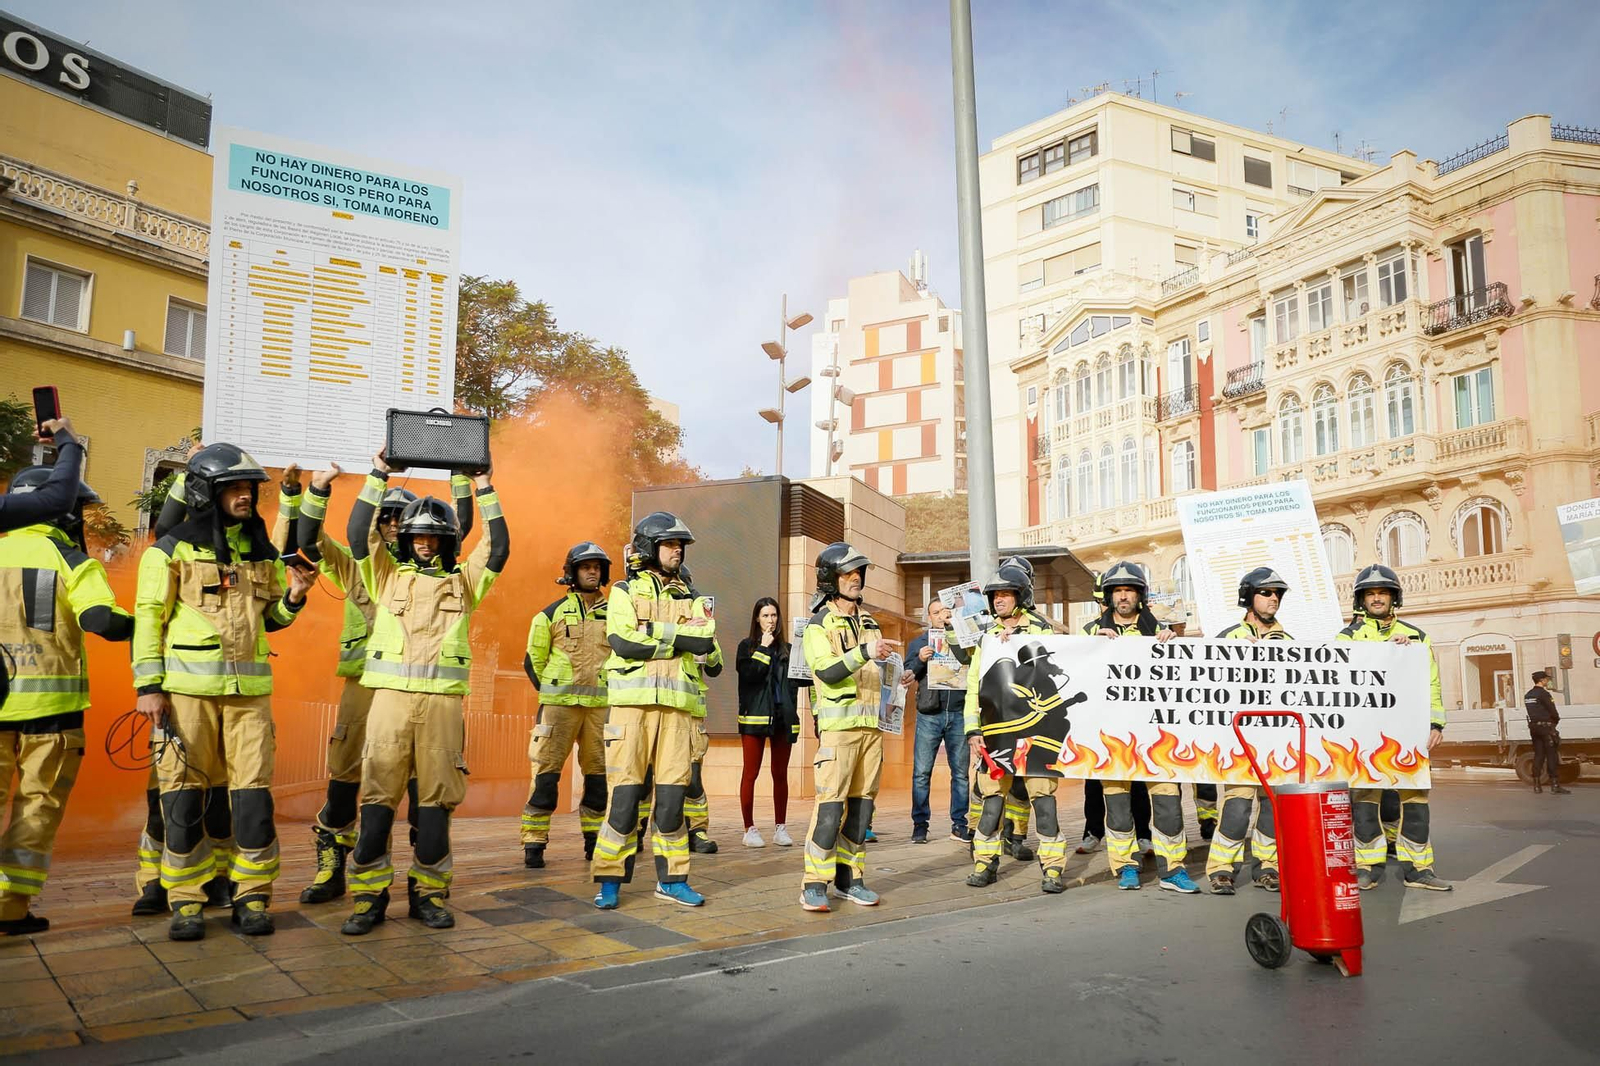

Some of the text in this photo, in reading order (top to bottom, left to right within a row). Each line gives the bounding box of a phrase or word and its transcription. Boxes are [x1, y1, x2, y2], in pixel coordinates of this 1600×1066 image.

[3, 31, 91, 90] OS
[255, 152, 429, 196] NO HAY DINERO PARA LOS
[251, 166, 432, 211] FUNCIONARIOS PERO PARA
[241, 178, 439, 226] NOSOTROS SI, TOMA MORENO
[1197, 497, 1294, 516] FUNCIONARIOS PERO PARA
[1225, 495, 1253, 505] DINERO
[1254, 492, 1274, 501] PARA
[1275, 490, 1290, 498] LOS
[1193, 512, 1234, 524] NOSOTROS
[1246, 508, 1267, 517] TOMA
[1268, 503, 1300, 513] MORENO
[1151, 643, 1351, 663] SIN INVERSIÓN
[1106, 664, 1387, 686] NO SE PUEDE DAR UN
[1106, 685, 1397, 708] SERVICIO DE CALIDAD
[1149, 708, 1181, 725] AL
